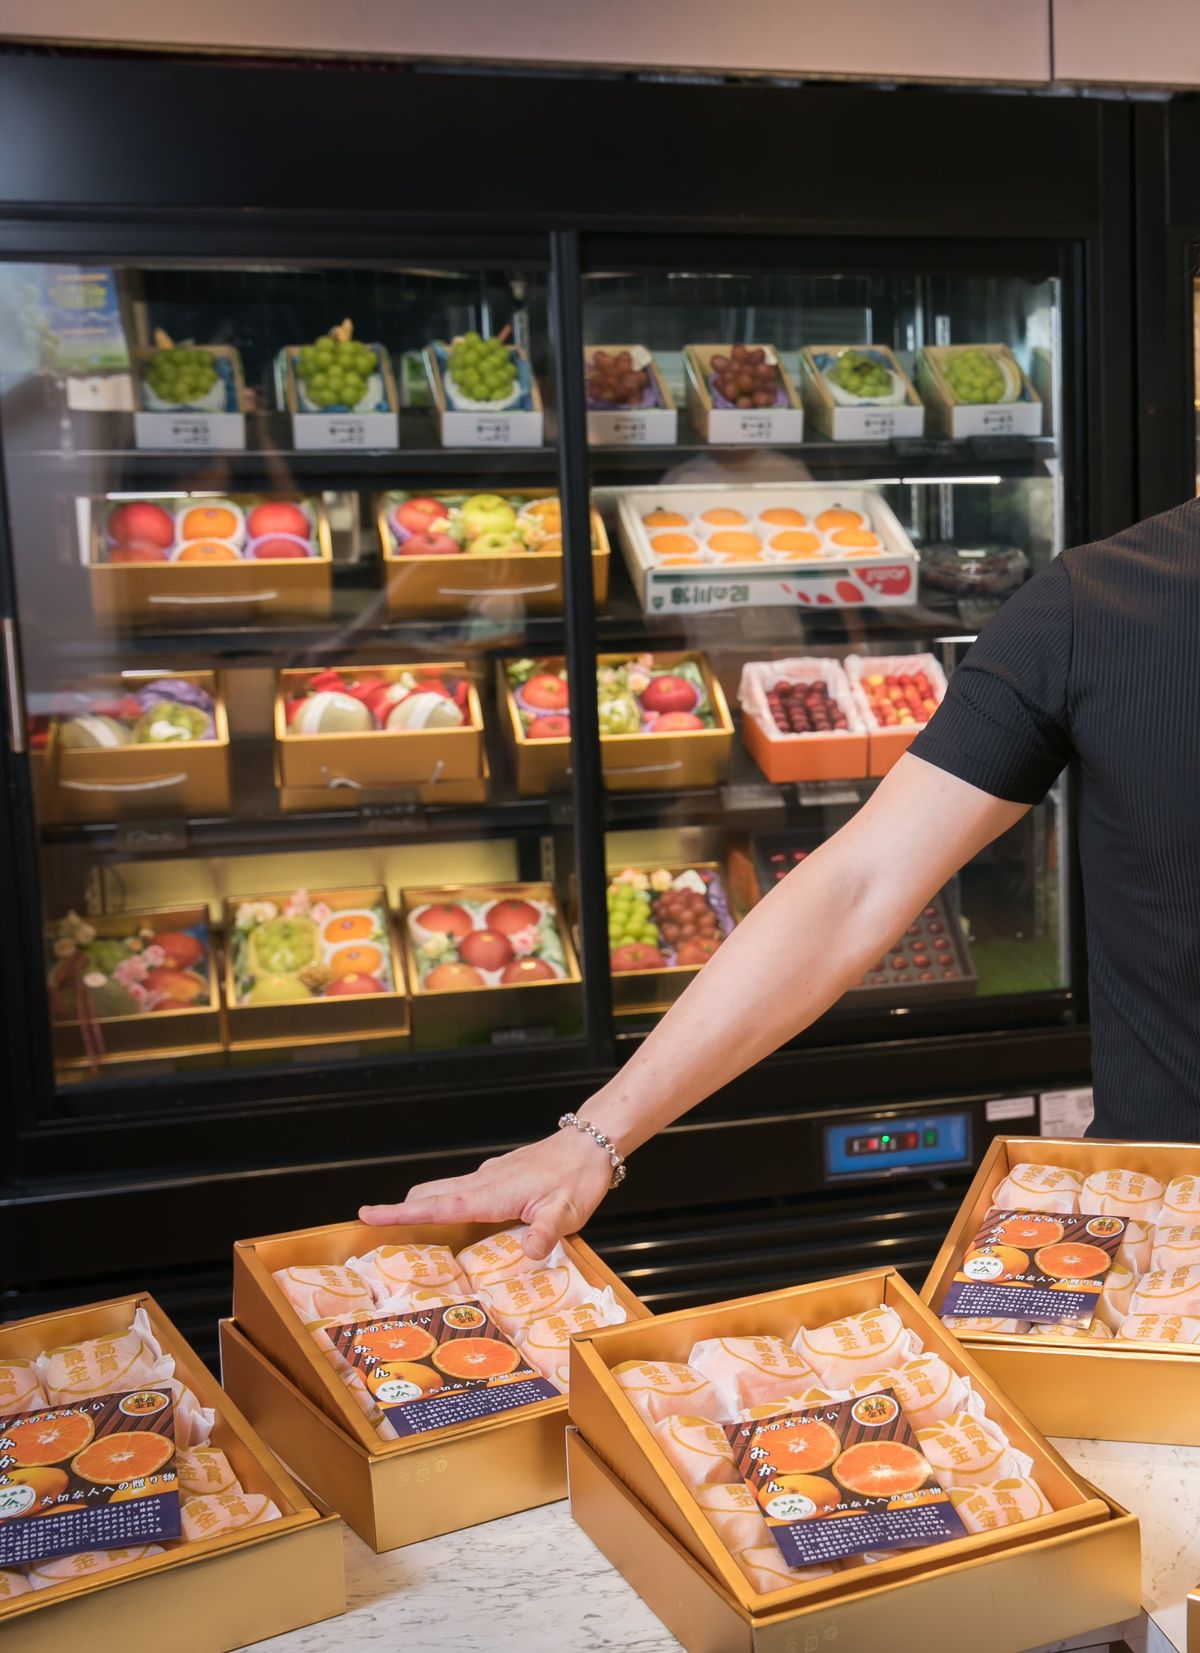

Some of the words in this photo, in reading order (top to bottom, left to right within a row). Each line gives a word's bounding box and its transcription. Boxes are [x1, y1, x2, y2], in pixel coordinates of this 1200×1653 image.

[999, 1214, 1077, 1224] 日本の美味しい
[980, 1227, 1006, 1254] みかん
[1004, 1274, 1103, 1287] 大切な人への贈り物
[343, 1316, 432, 1337] 日本の美味しい
[354, 1345, 390, 1378] みかん
[427, 1369, 536, 1394] 大切な人への贈り物
[741, 1411, 839, 1437] 日本の美味しい
[750, 1447, 784, 1493] みかん
[41, 1473, 176, 1506] 大切な人への贈り物
[822, 1487, 942, 1512] 大切な人への贈り物
